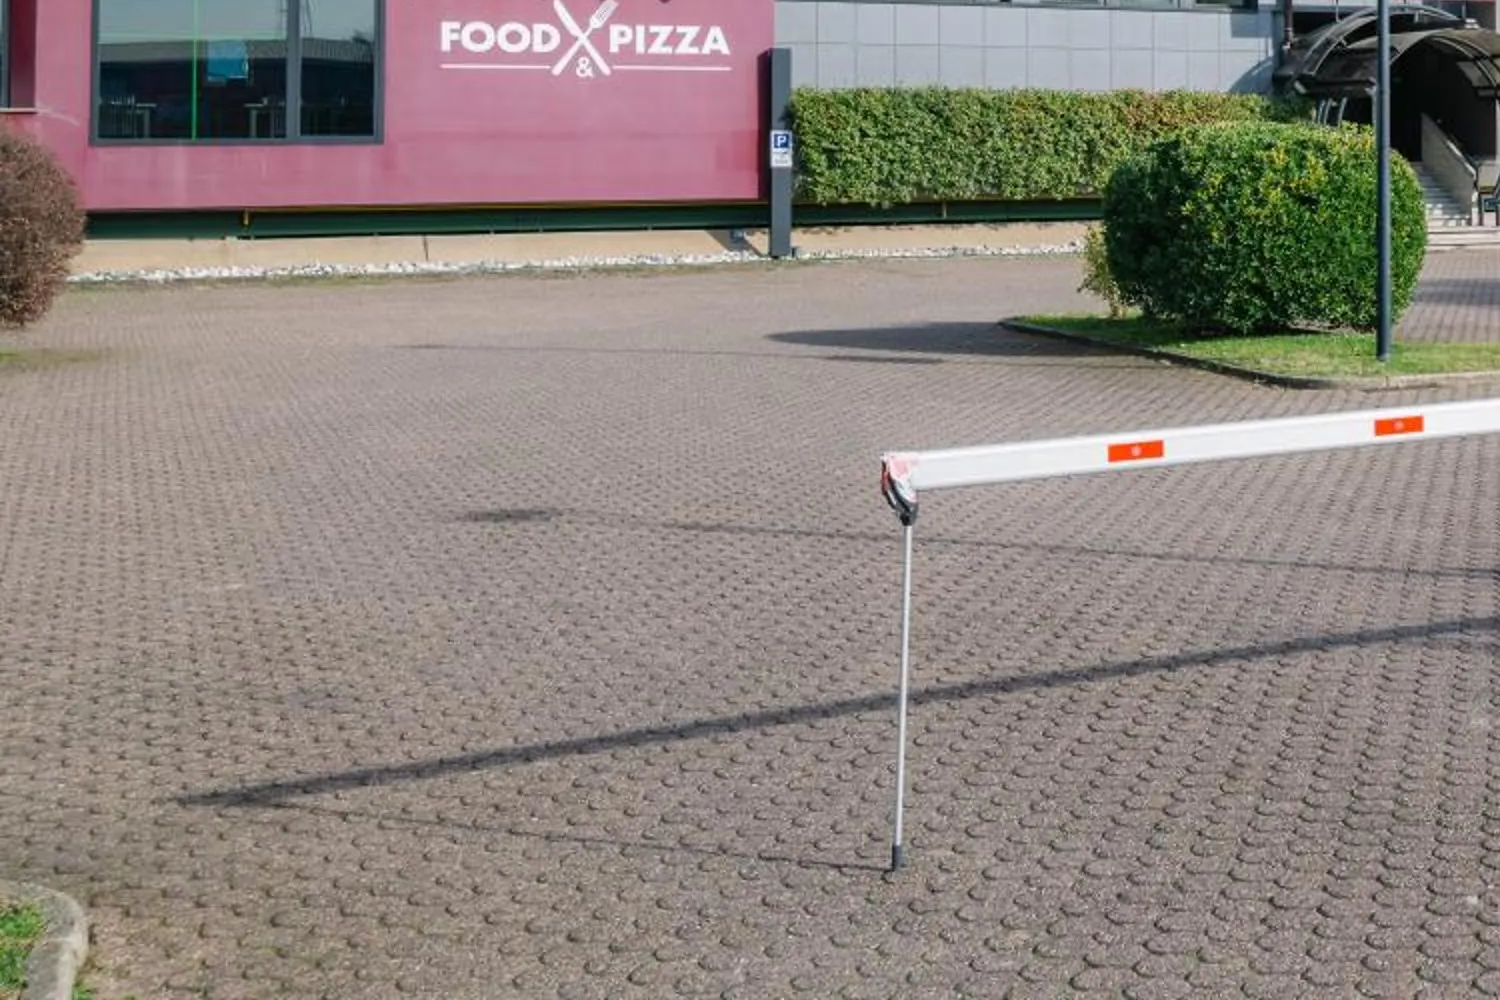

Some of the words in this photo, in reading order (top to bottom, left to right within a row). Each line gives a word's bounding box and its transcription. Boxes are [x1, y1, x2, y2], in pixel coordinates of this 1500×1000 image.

[440, 21, 560, 53] FOOD
[575, 56, 594, 78] &
[609, 24, 731, 55] PIZZA
[777, 135, 787, 147] P
